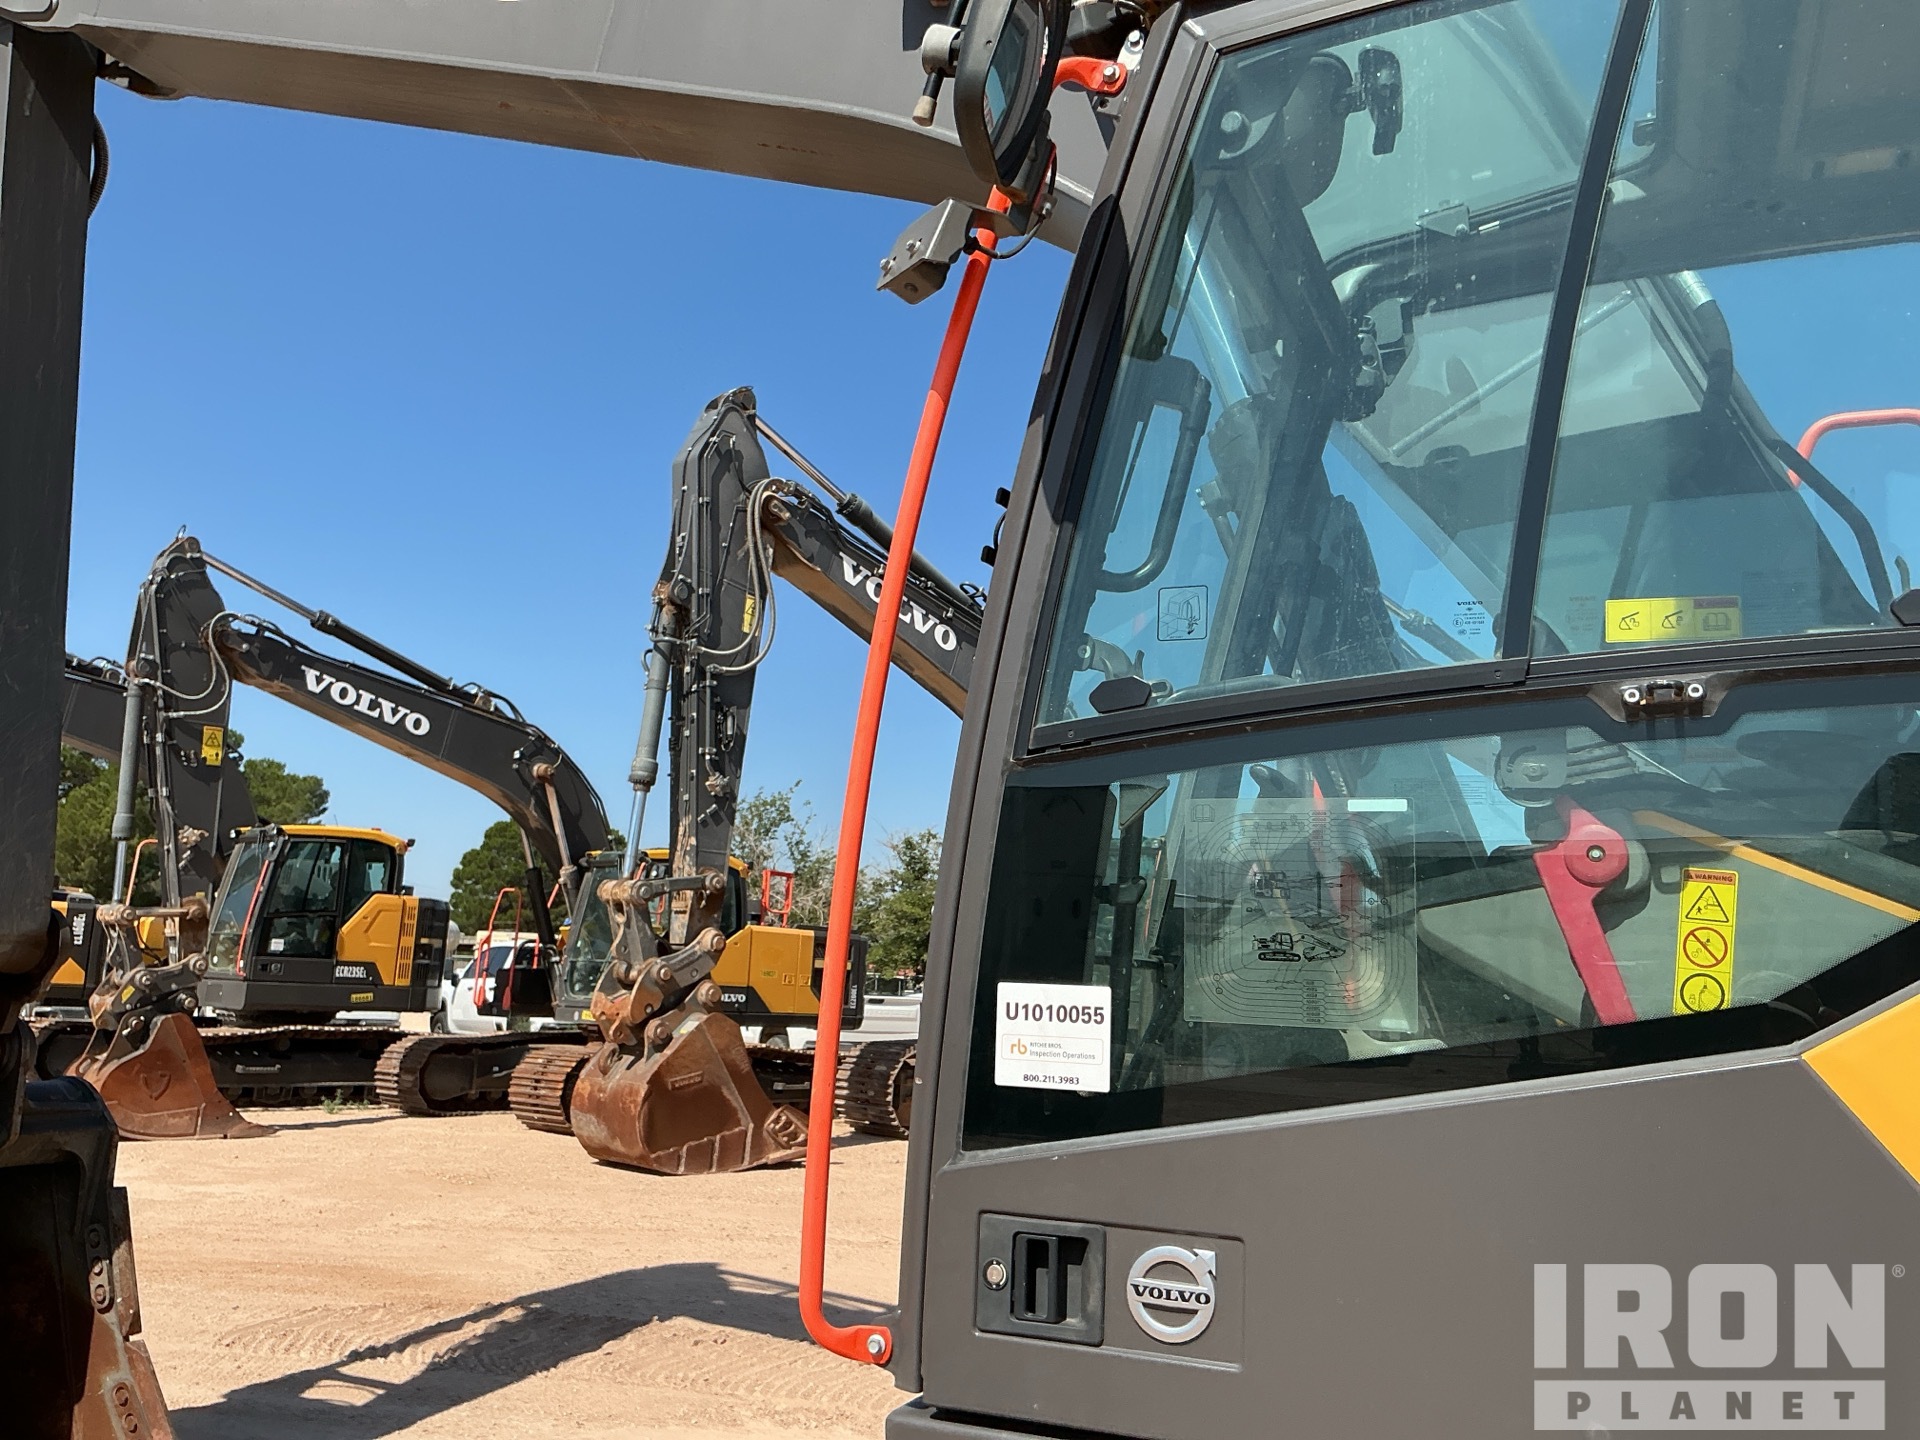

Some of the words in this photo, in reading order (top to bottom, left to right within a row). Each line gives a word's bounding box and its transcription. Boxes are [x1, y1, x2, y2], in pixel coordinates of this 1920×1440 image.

[301, 665, 431, 736] VOLVO
[1695, 873, 1733, 882] WARNING
[1005, 1002, 1105, 1025] U1010055
[1010, 1038, 1028, 1055] rb
[1029, 1049, 1061, 1058] Inspection
[1062, 1051, 1096, 1060] Operations
[1023, 1074, 1080, 1085] 800.211.3983
[1130, 1283, 1211, 1305] VOLVO
